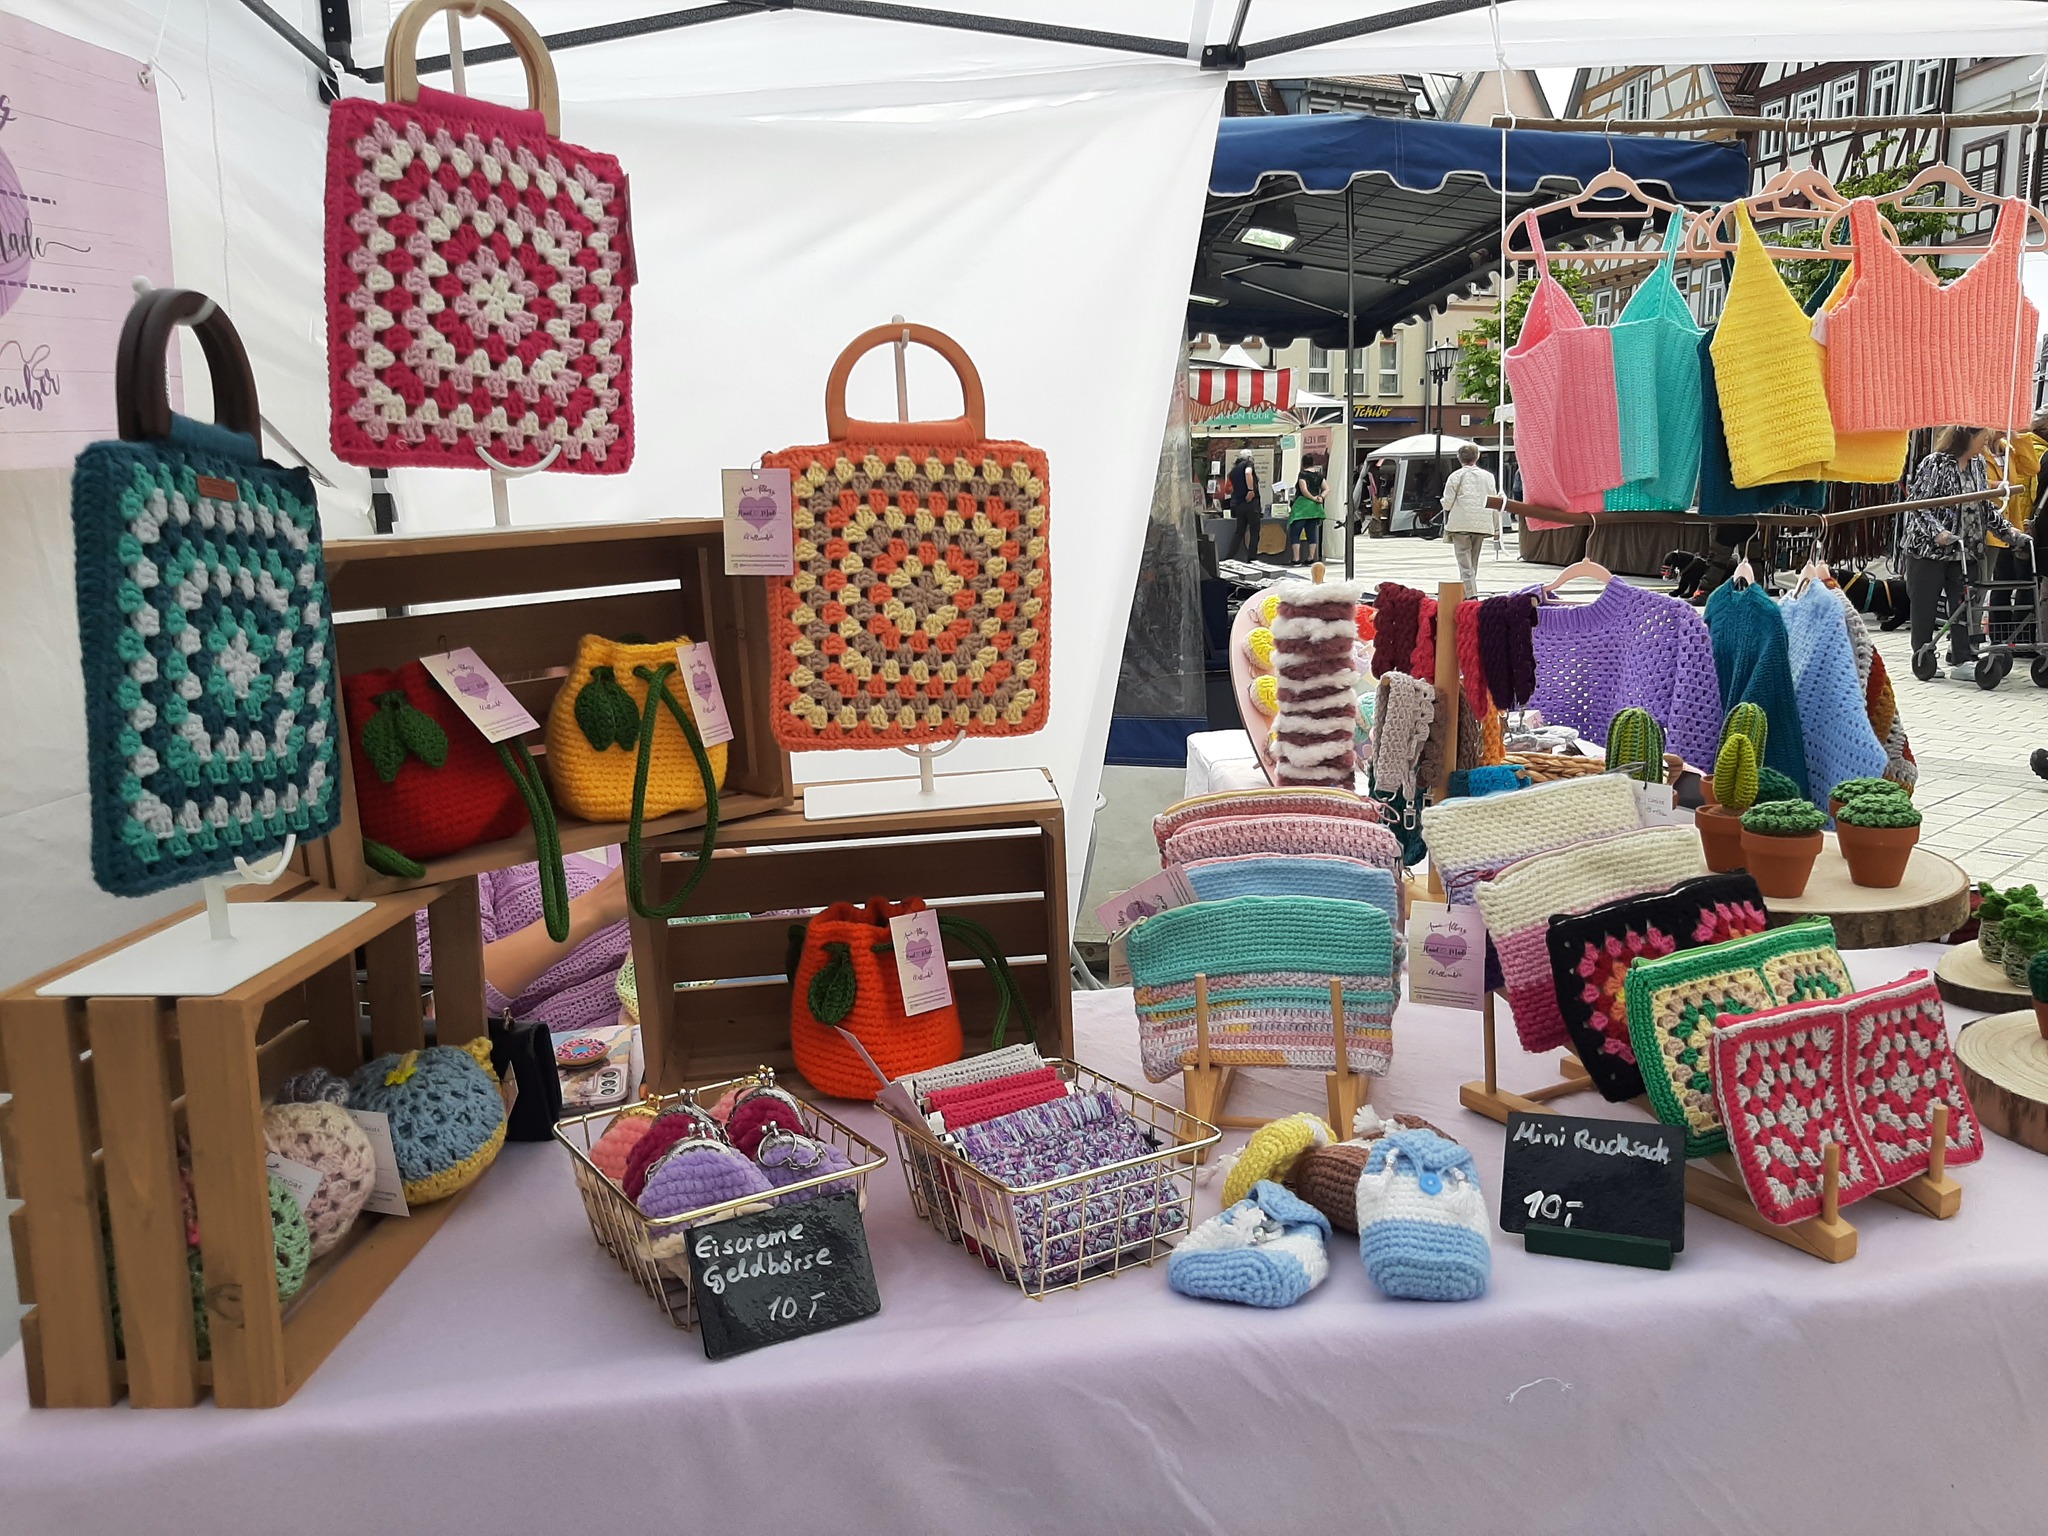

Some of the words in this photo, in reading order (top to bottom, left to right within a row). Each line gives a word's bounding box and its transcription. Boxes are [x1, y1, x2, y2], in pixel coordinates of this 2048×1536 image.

[1231, 412, 1245, 420] ON
[1247, 412, 1270, 420] TOUR
[1353, 405, 1392, 418] Tchibo
[1513, 1121, 1567, 1147] Mini
[1573, 1128, 1672, 1165] Rucksack
[694, 1223, 804, 1259] Eiscreme
[702, 1247, 833, 1295] Geldbörse
